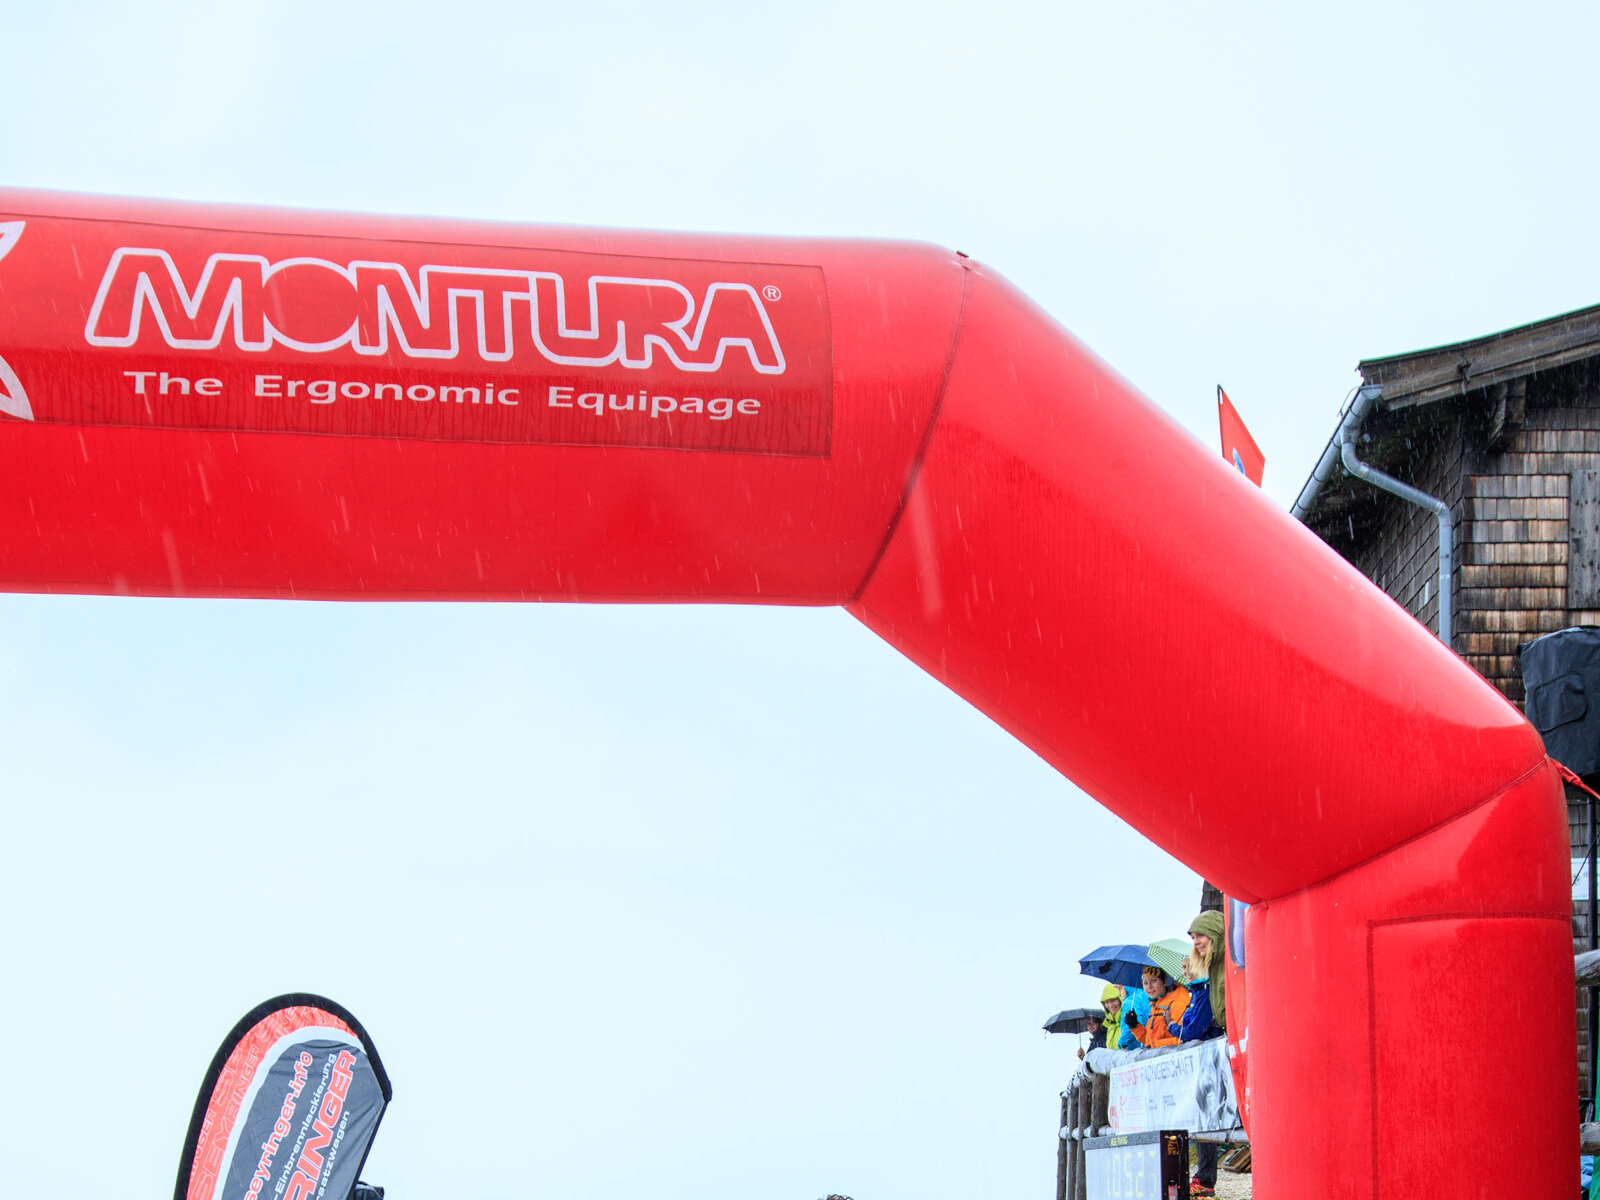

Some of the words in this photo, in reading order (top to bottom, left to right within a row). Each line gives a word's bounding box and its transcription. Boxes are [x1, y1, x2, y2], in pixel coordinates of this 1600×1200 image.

[123, 370, 224, 397] The
[253, 374, 521, 407] Ergonomic
[548, 386, 762, 421] Equipage
